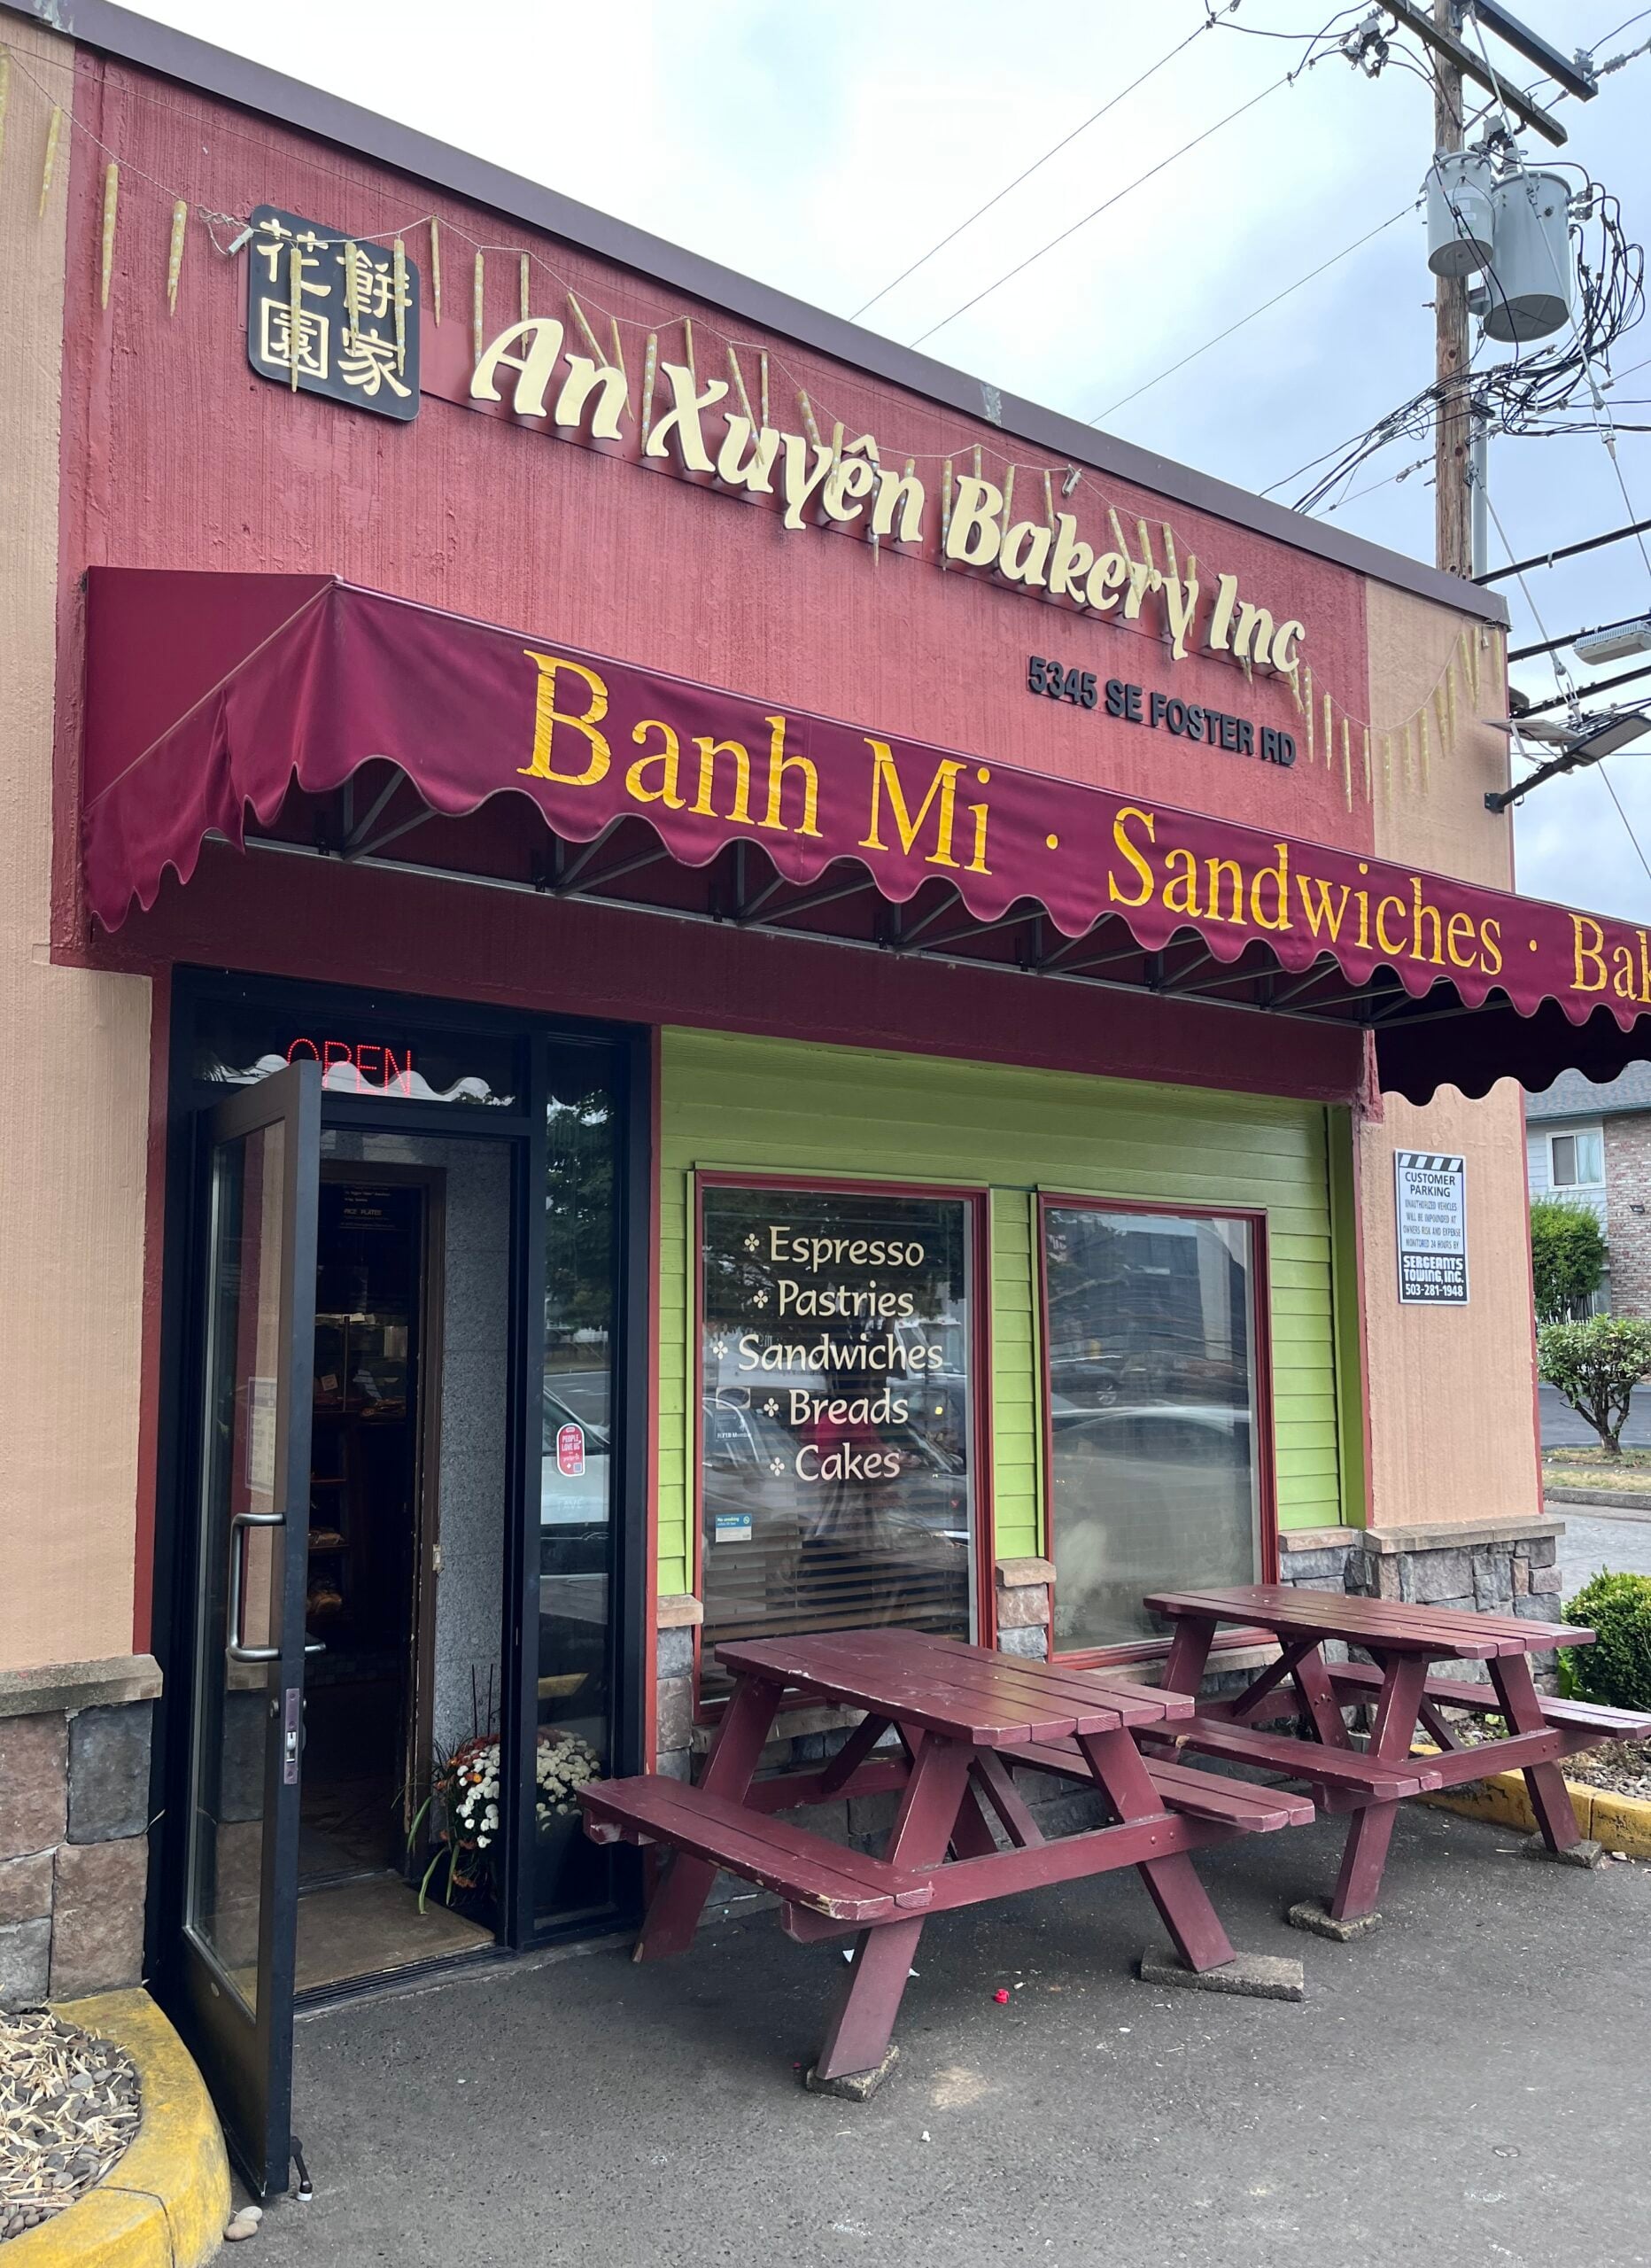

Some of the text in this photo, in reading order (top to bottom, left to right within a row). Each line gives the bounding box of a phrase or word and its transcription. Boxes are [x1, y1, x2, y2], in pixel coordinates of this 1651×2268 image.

[470, 317, 1306, 673] An Xuyên Bakery Inc
[1028, 655, 1297, 766] 5345 SE FOSTER RD
[516, 649, 824, 838] Banh
[857, 737, 993, 875] Mi
[1107, 805, 1503, 975] Sandwiches
[1405, 1171, 1456, 1185] CUSTOMER
[1410, 1184, 1451, 1198] PARKING
[768, 1225, 925, 1273] Espresso
[1403, 1254, 1463, 1270] SERGEANTS
[778, 1280, 914, 1317] Pastries
[1405, 1283, 1464, 1297] 503-281-1948
[738, 1332, 944, 1371] Sandwiches
[788, 1387, 910, 1425] Breads
[794, 1442, 902, 1481] Cakes
